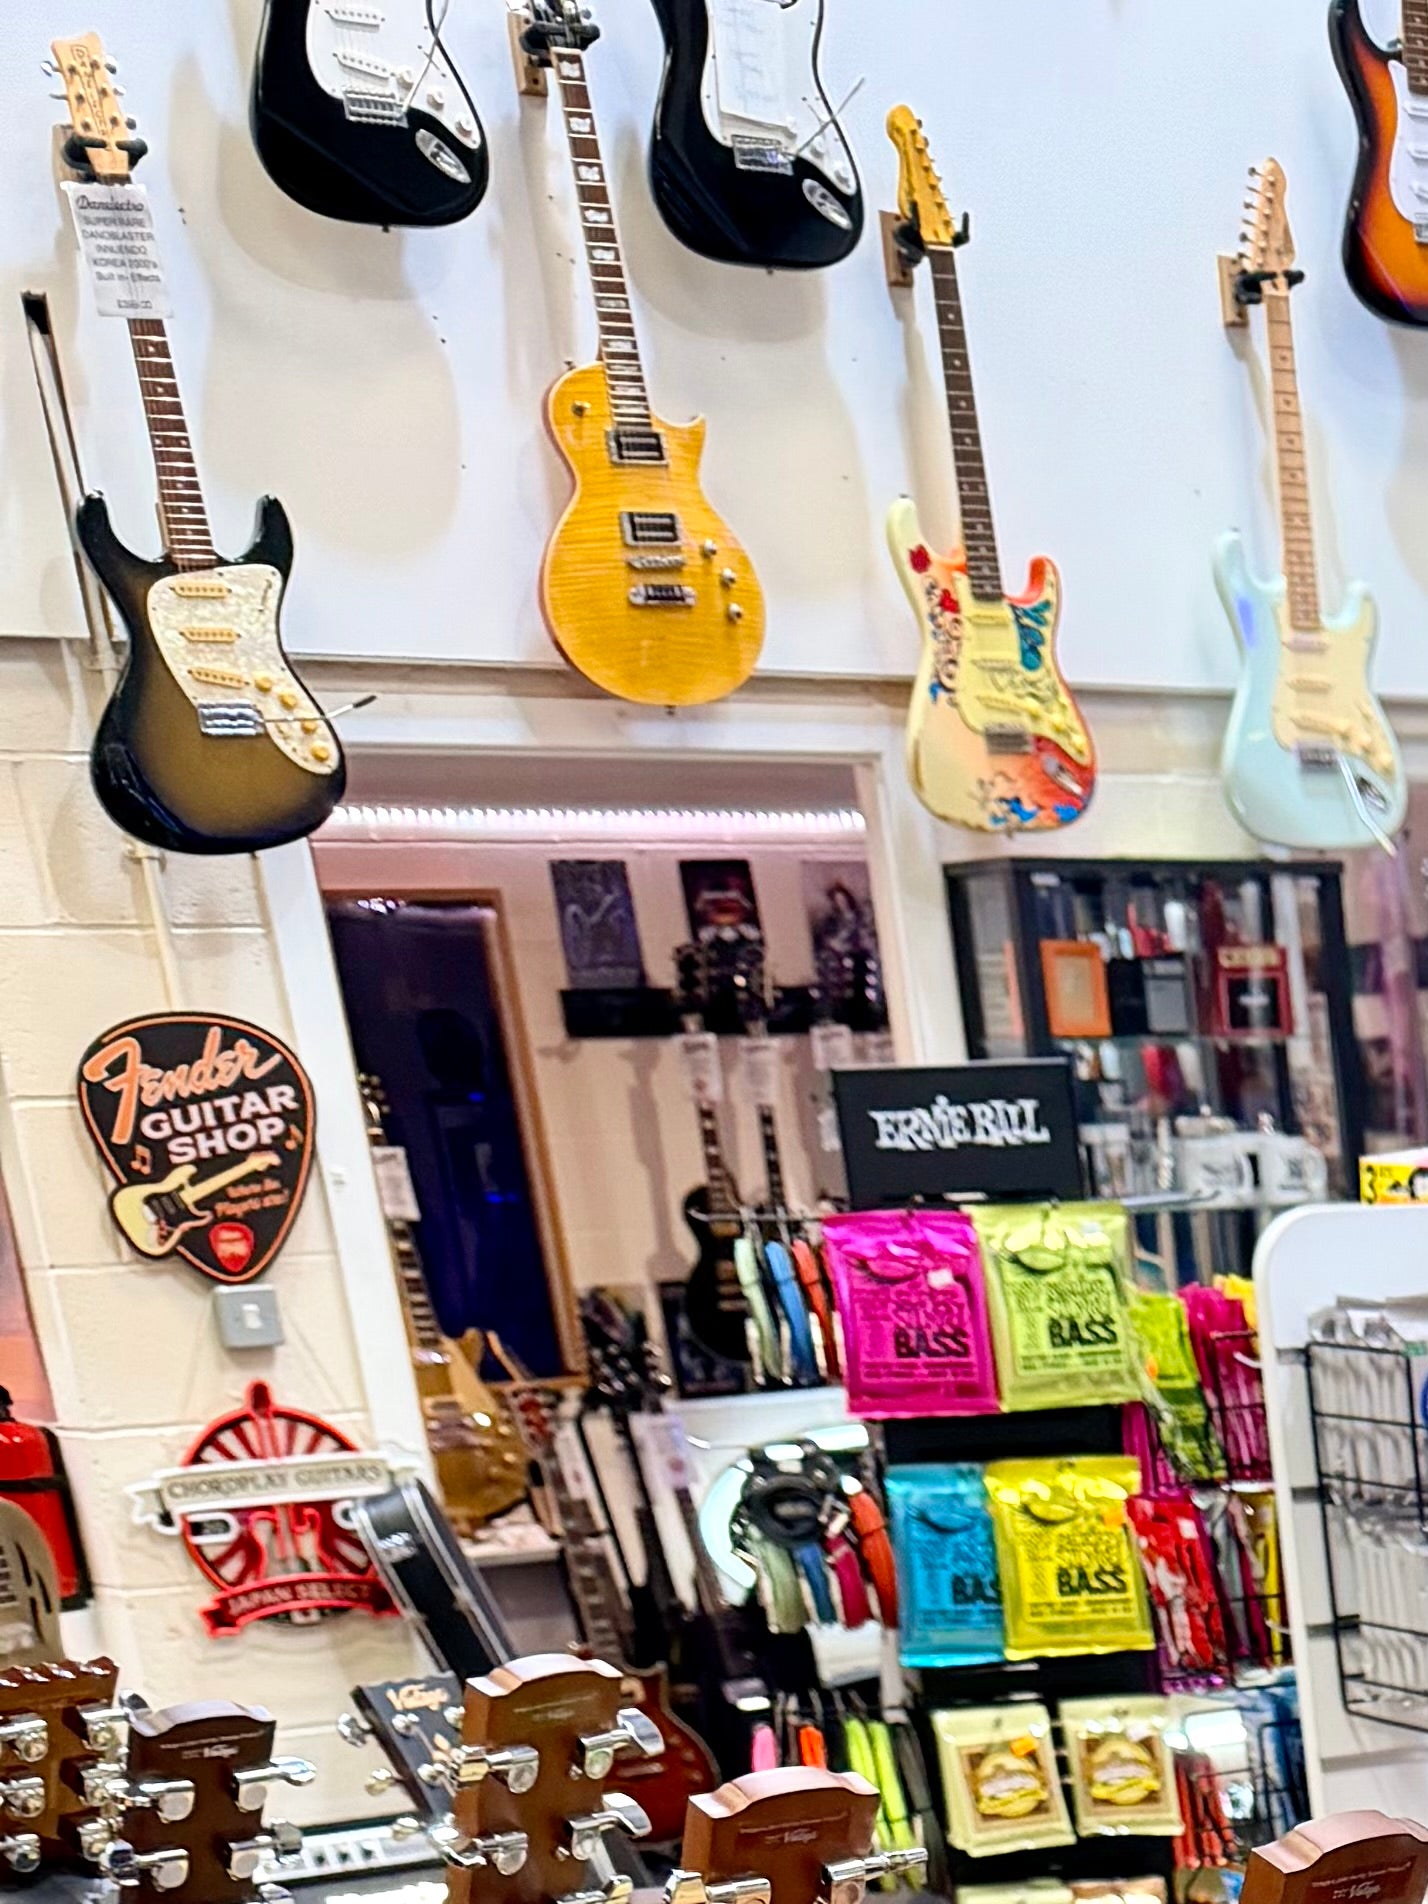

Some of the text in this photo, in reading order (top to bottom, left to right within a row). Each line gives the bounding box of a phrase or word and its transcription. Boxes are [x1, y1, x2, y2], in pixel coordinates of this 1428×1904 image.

[82, 1025, 283, 1145] Fender
[139, 1084, 300, 1140] GUITAR
[867, 1093, 1052, 1151] ERNIE BALL
[166, 1116, 286, 1164] SHOP
[892, 1326, 971, 1360] BASS
[1050, 1314, 1119, 1349] BASS
[951, 1573, 1001, 1605] BAS
[1055, 1565, 1128, 1598] BASS
